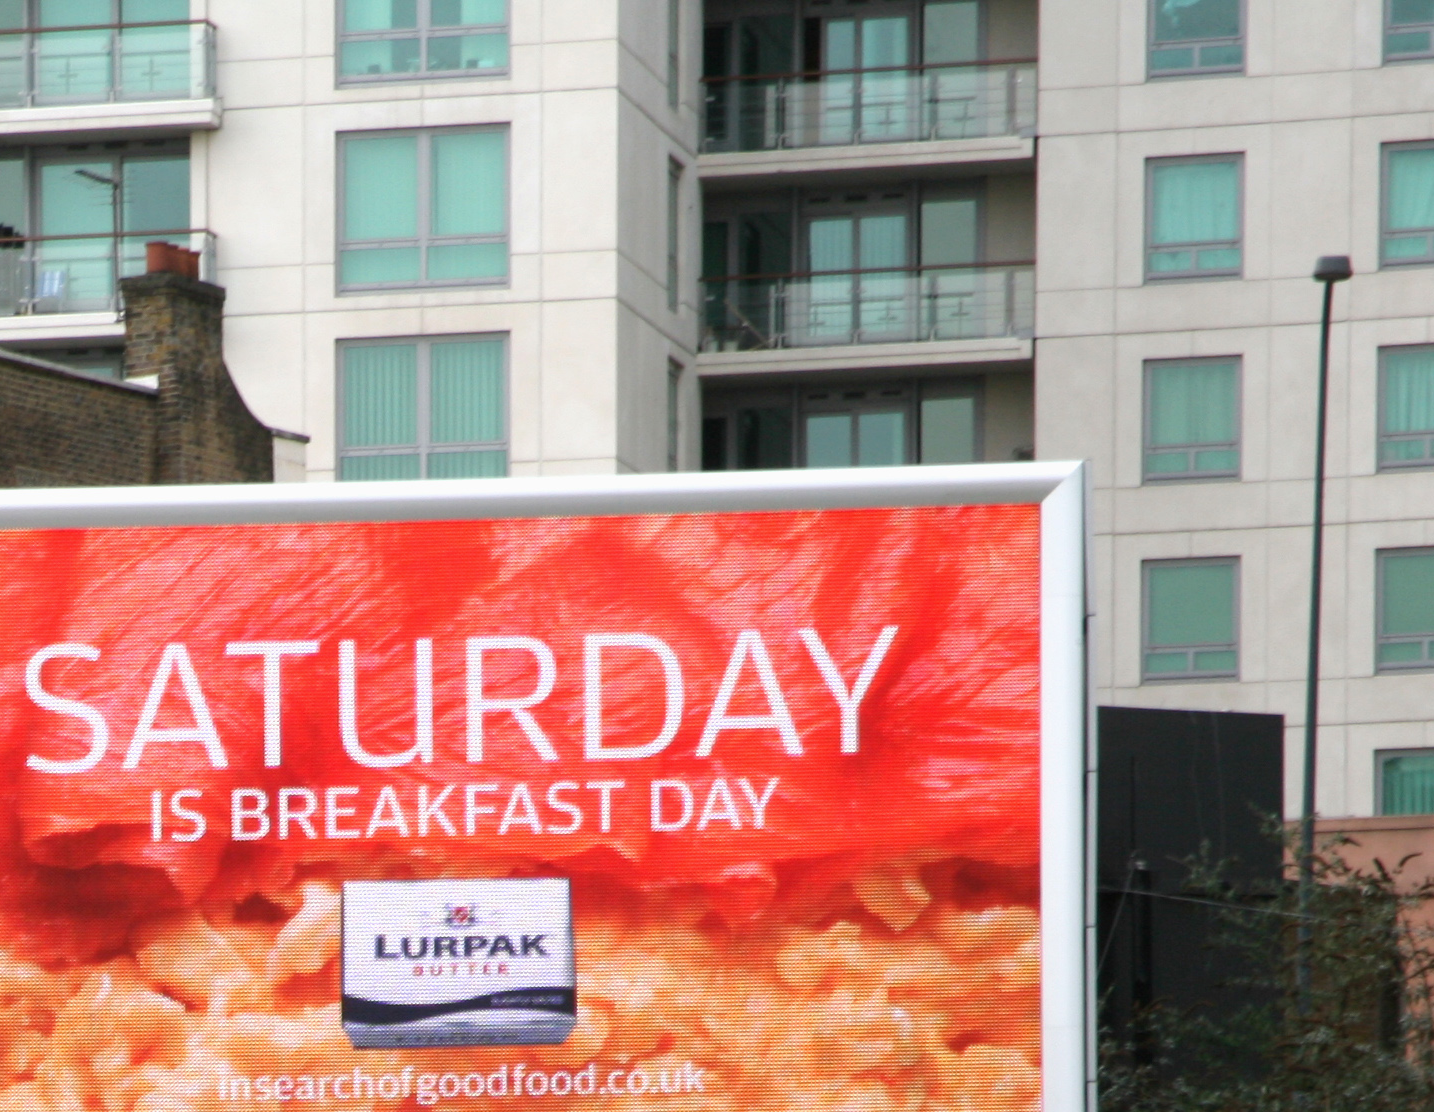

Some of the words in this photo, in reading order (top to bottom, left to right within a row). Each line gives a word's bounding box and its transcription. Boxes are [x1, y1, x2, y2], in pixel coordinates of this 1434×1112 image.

[23, 625, 900, 774] SATURDAY
[150, 789, 206, 843] IS
[231, 780, 625, 841] BREAKFAST
[650, 777, 780, 832] DAY
[374, 934, 548, 959] LURPAK
[412, 963, 510, 977] BUTTER
[218, 1062, 705, 1105] insearchofgoodfood.co.uk
